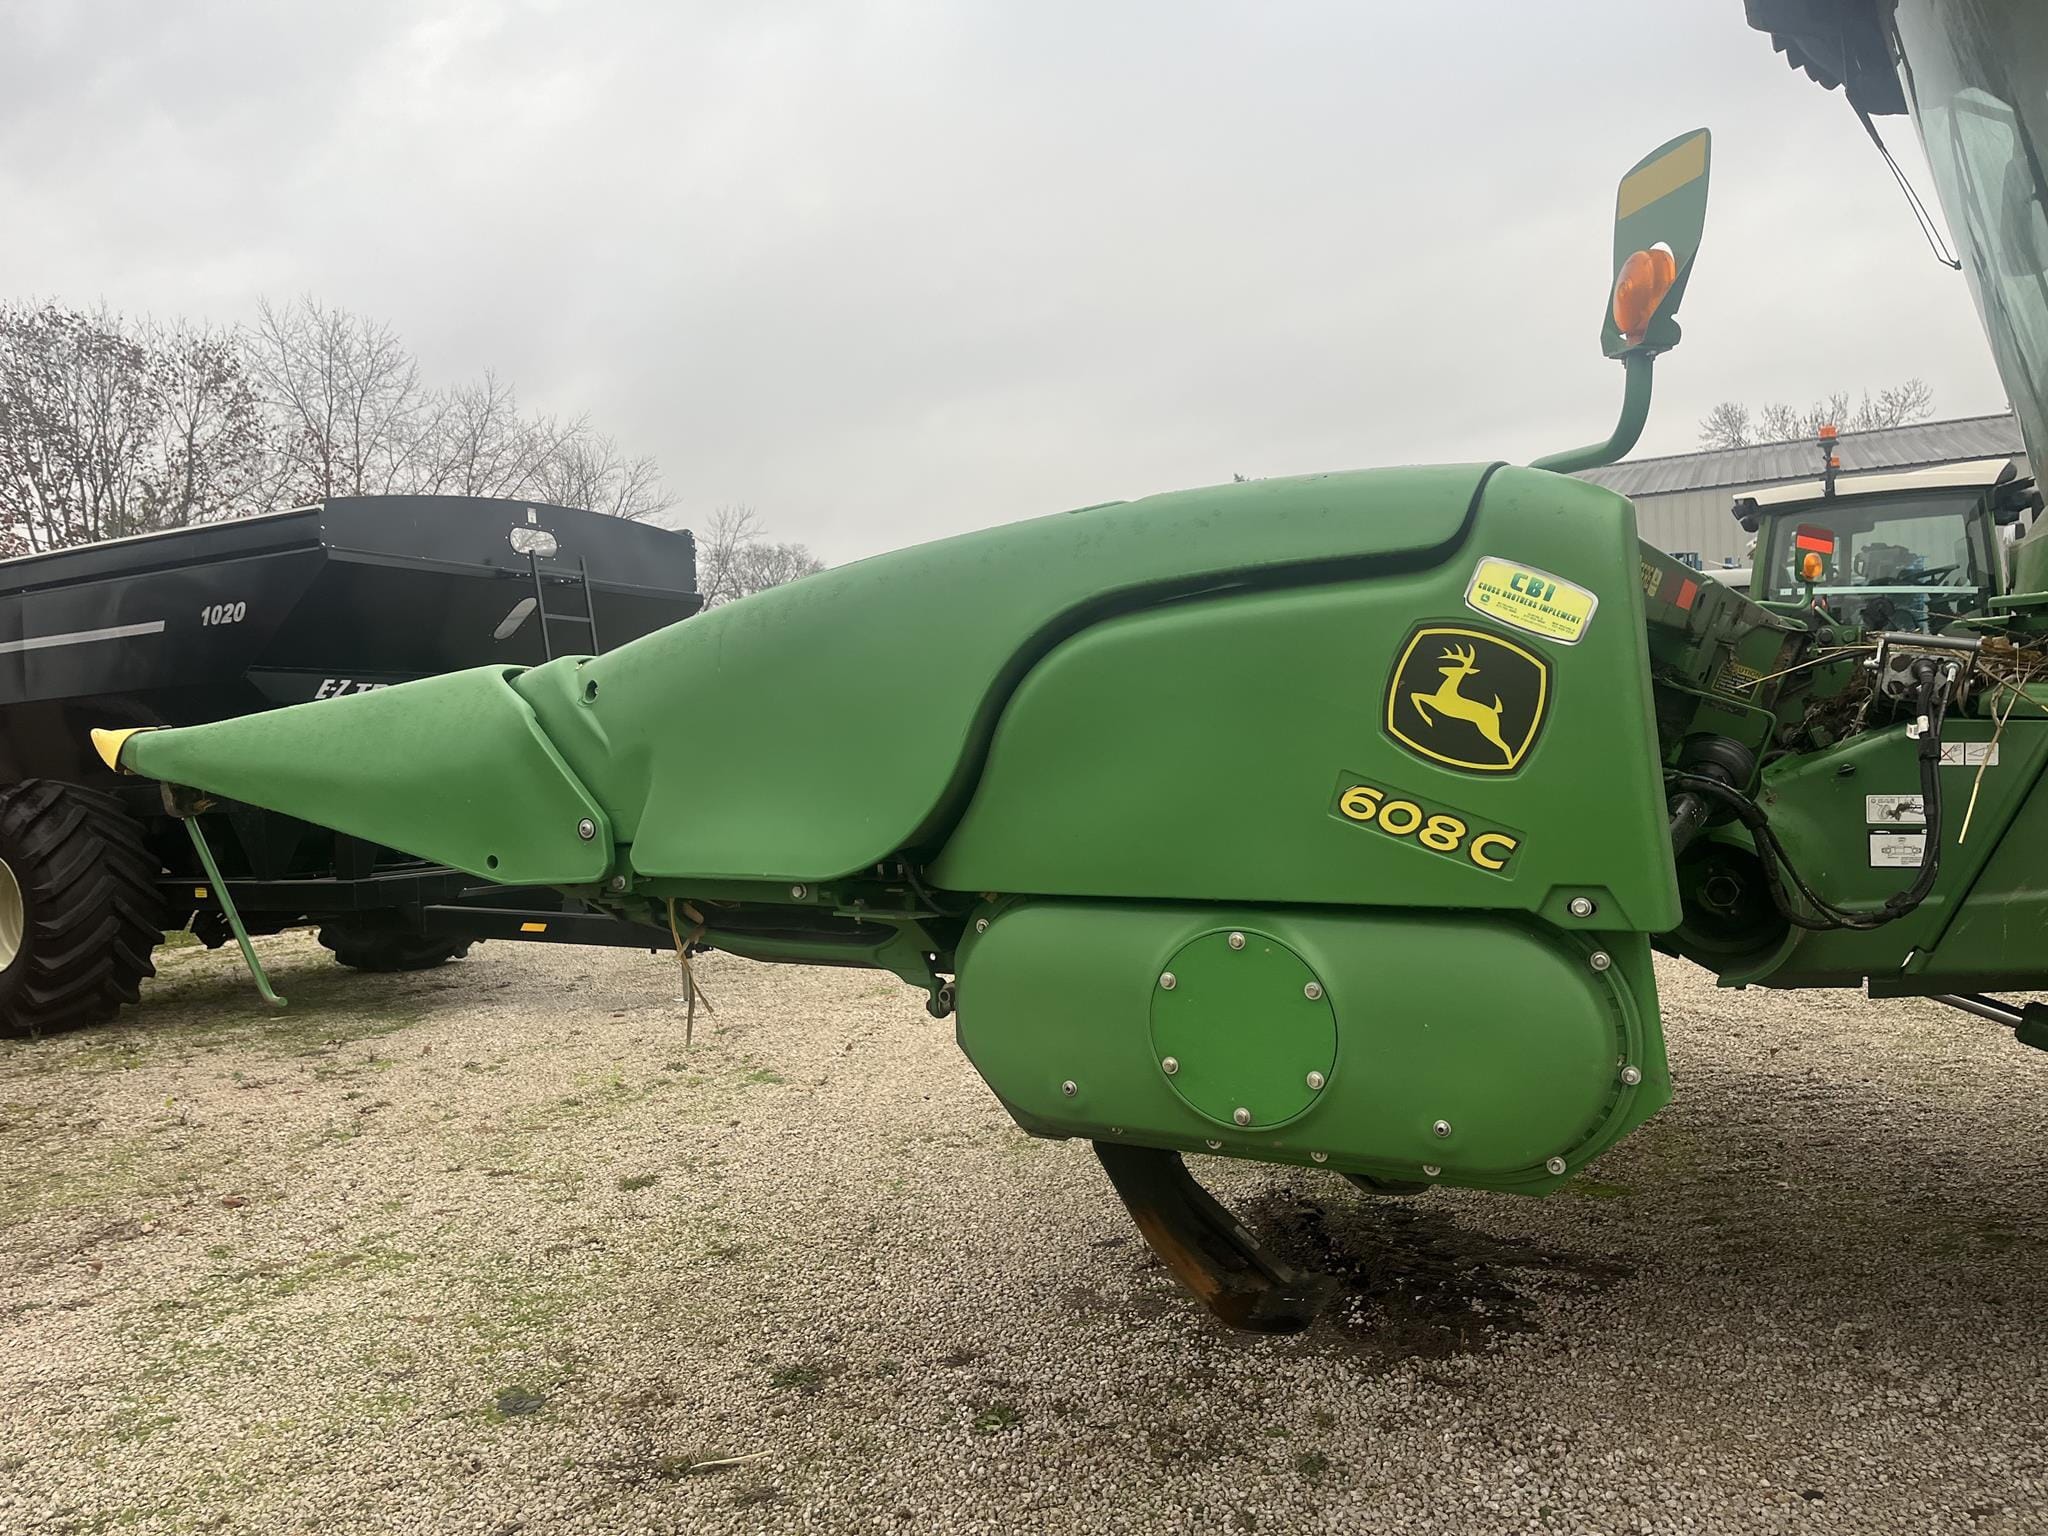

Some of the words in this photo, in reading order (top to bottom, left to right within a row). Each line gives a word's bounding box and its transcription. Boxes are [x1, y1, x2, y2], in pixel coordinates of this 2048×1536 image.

[1510, 572, 1556, 602] CBI
[201, 601, 247, 626] 1020
[1502, 591, 1538, 609] BROTHERS
[1538, 602, 1582, 624] IMPLEMENT
[314, 678, 352, 699] E-Z
